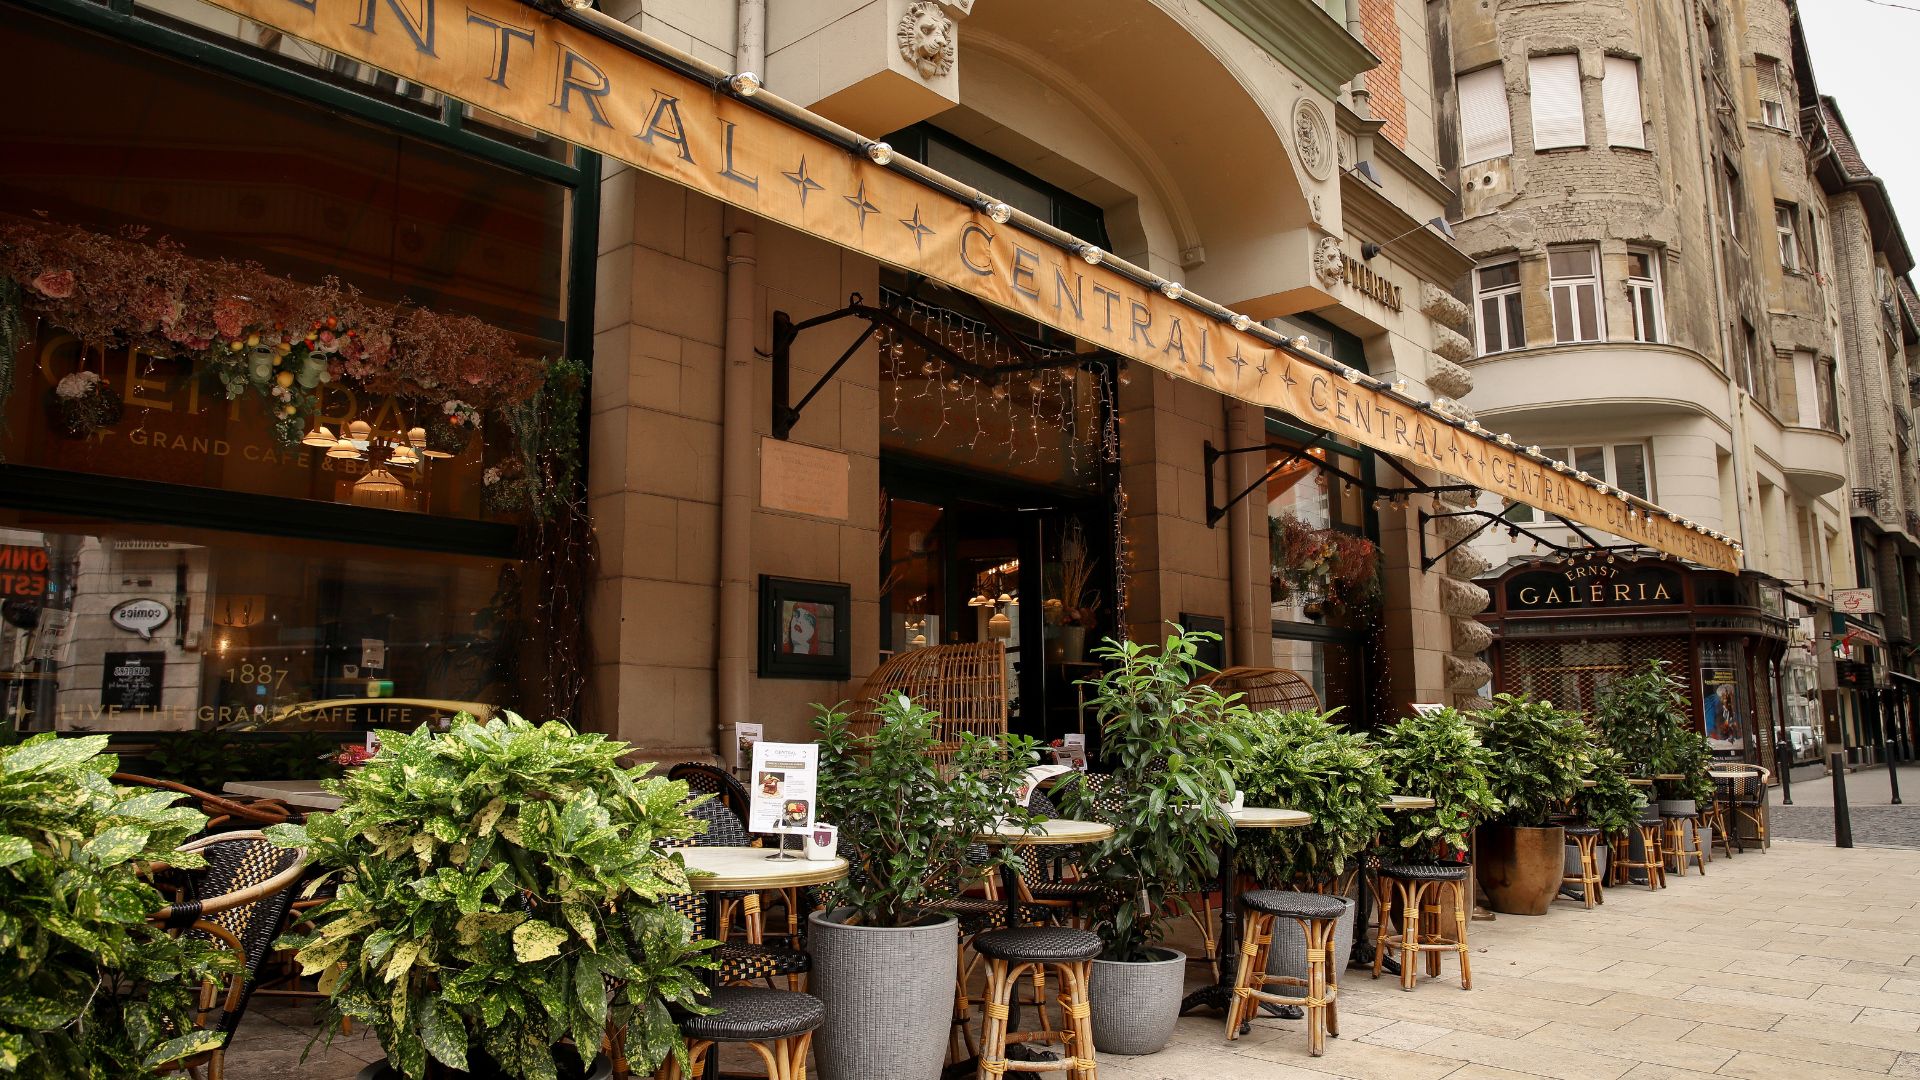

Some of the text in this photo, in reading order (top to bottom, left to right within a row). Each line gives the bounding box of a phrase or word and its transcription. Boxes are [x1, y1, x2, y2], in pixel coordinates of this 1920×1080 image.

[287, 0, 759, 193] NTRAL
[959, 220, 1216, 376] CENTRAL
[1310, 373, 1443, 461] CENTRAL
[1492, 454, 1575, 511] CENTRAL
[1606, 503, 1663, 543] CENTRAL
[129, 427, 231, 457] GRAND
[320, 456, 335, 473] &
[1565, 565, 1619, 581] ERNST
[1519, 580, 1671, 605] GALÉRIA
[226, 664, 289, 690] 1887
[60, 703, 123, 721] LIVE
[133, 704, 187, 721] THE
[299, 707, 357, 723] CAFE
[366, 708, 412, 723] LIFE
